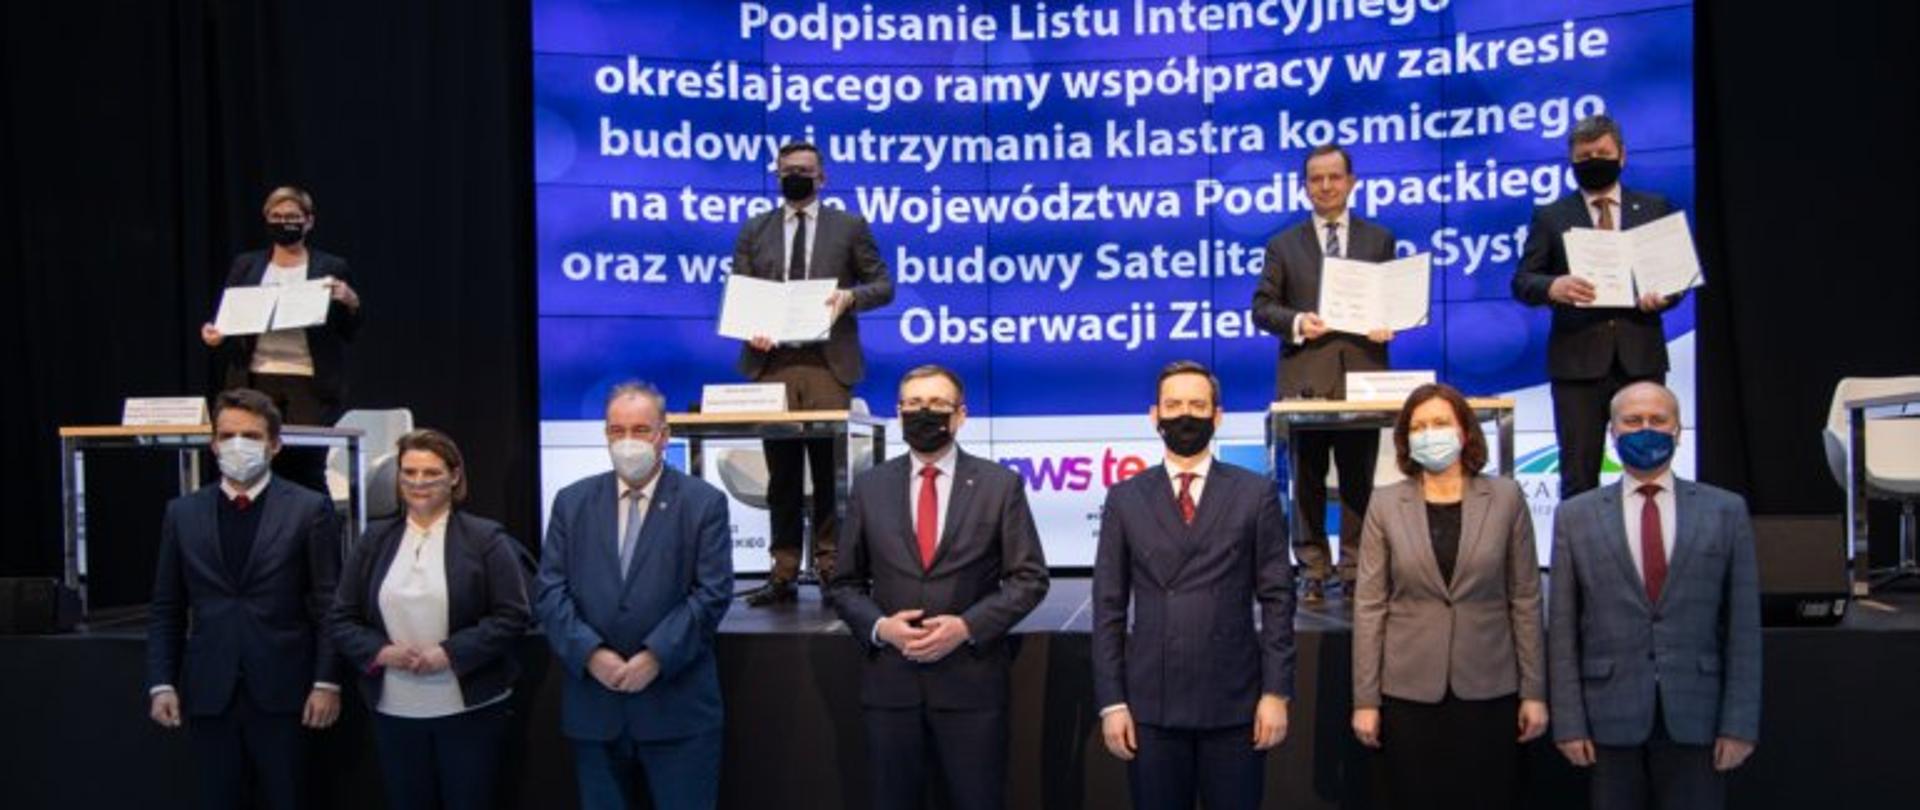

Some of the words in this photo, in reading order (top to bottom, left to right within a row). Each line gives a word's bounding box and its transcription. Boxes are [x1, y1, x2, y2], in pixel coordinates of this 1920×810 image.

[740, 2, 997, 50] Podpisanie
[1011, 3, 1119, 41] Listu
[595, 55, 923, 113] określającego
[935, 72, 1051, 111] ramy
[1061, 55, 1333, 107] współpracy
[1345, 51, 1387, 82] w
[1397, 20, 1609, 80] zakresie
[600, 116, 792, 172] budowy
[829, 123, 1092, 173] utrzymania
[1106, 118, 1264, 158] klastra
[1279, 93, 1606, 149] kosmicznego
[610, 190, 668, 221] na
[855, 181, 1181, 234] Województwa
[562, 252, 667, 283] oraz
[897, 246, 1083, 290] budowy
[899, 301, 1156, 350] Obserwacji
